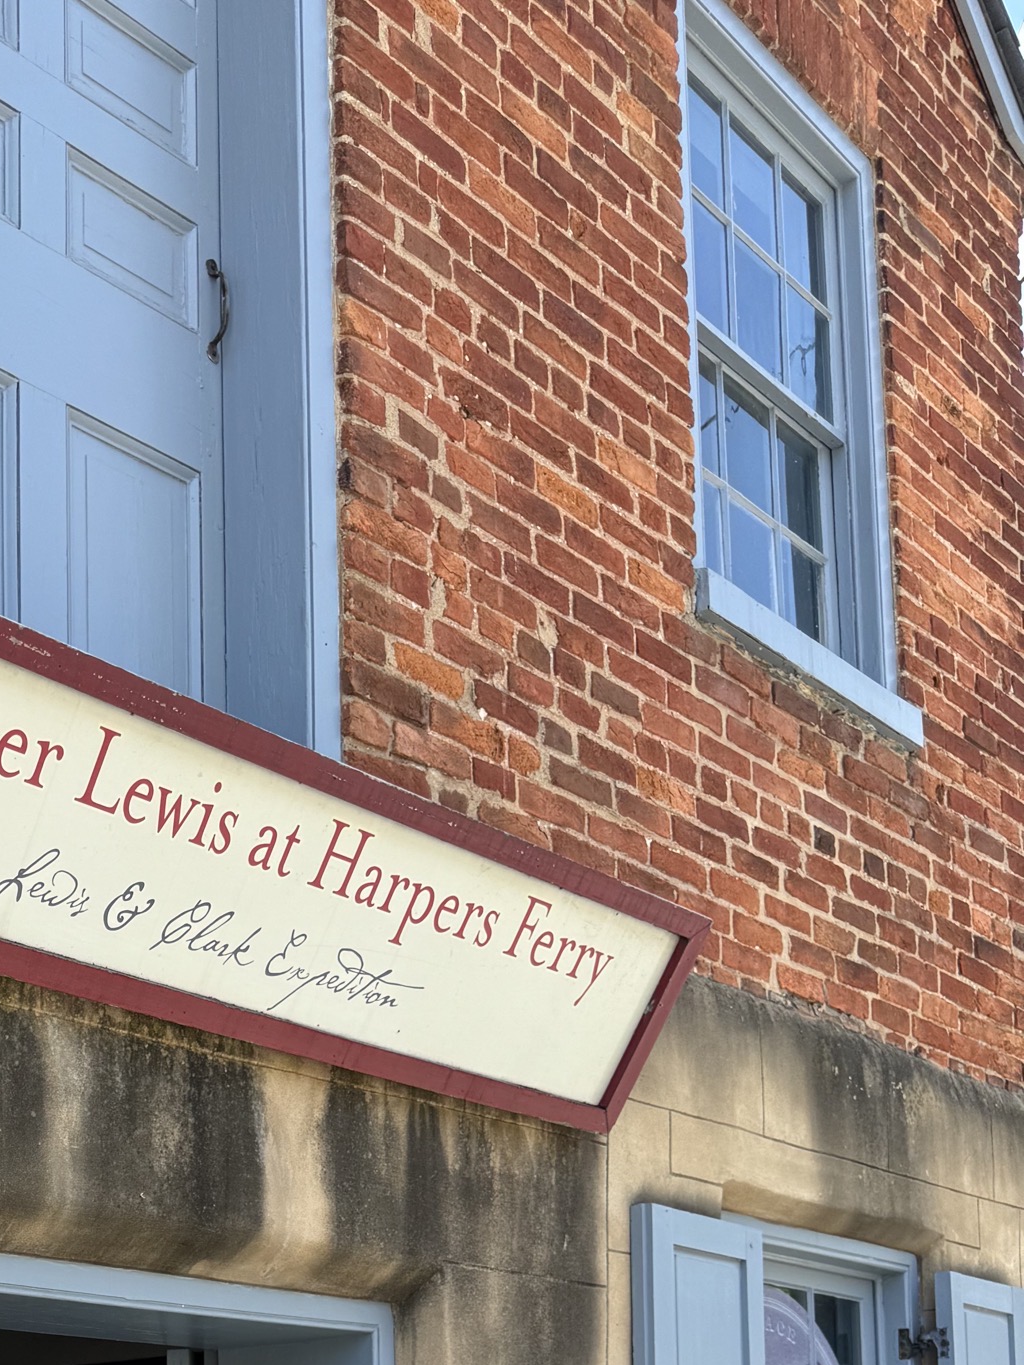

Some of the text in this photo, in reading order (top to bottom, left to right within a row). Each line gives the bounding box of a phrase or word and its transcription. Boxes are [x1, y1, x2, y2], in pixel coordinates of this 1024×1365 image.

[73, 725, 239, 855] Lewis
[247, 825, 302, 877] at
[306, 818, 501, 946] Harpers
[503, 895, 614, 1007] Ferry
[102, 881, 156, 932] &
[149, 899, 262, 967] Clark
[266, 928, 425, 1012] Expedition
